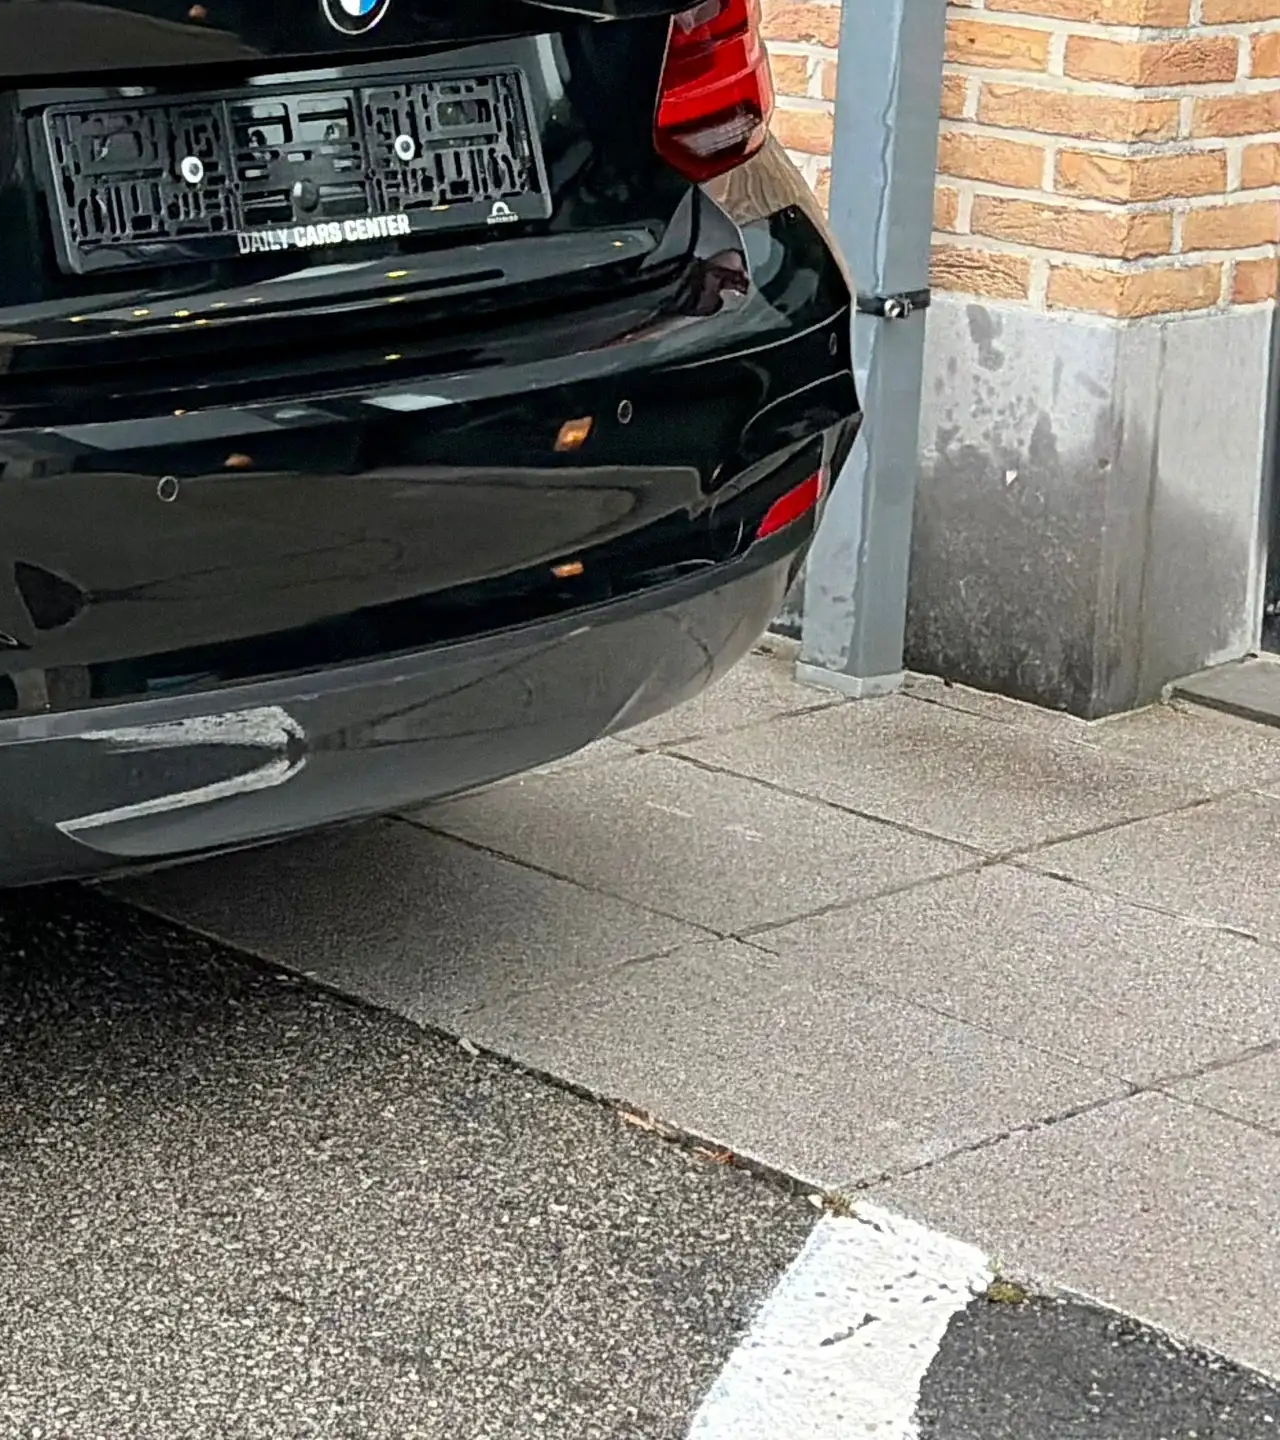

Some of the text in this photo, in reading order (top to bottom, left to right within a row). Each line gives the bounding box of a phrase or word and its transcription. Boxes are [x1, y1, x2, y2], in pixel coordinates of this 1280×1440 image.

[238, 213, 411, 254] DAILY CARS CENTER
